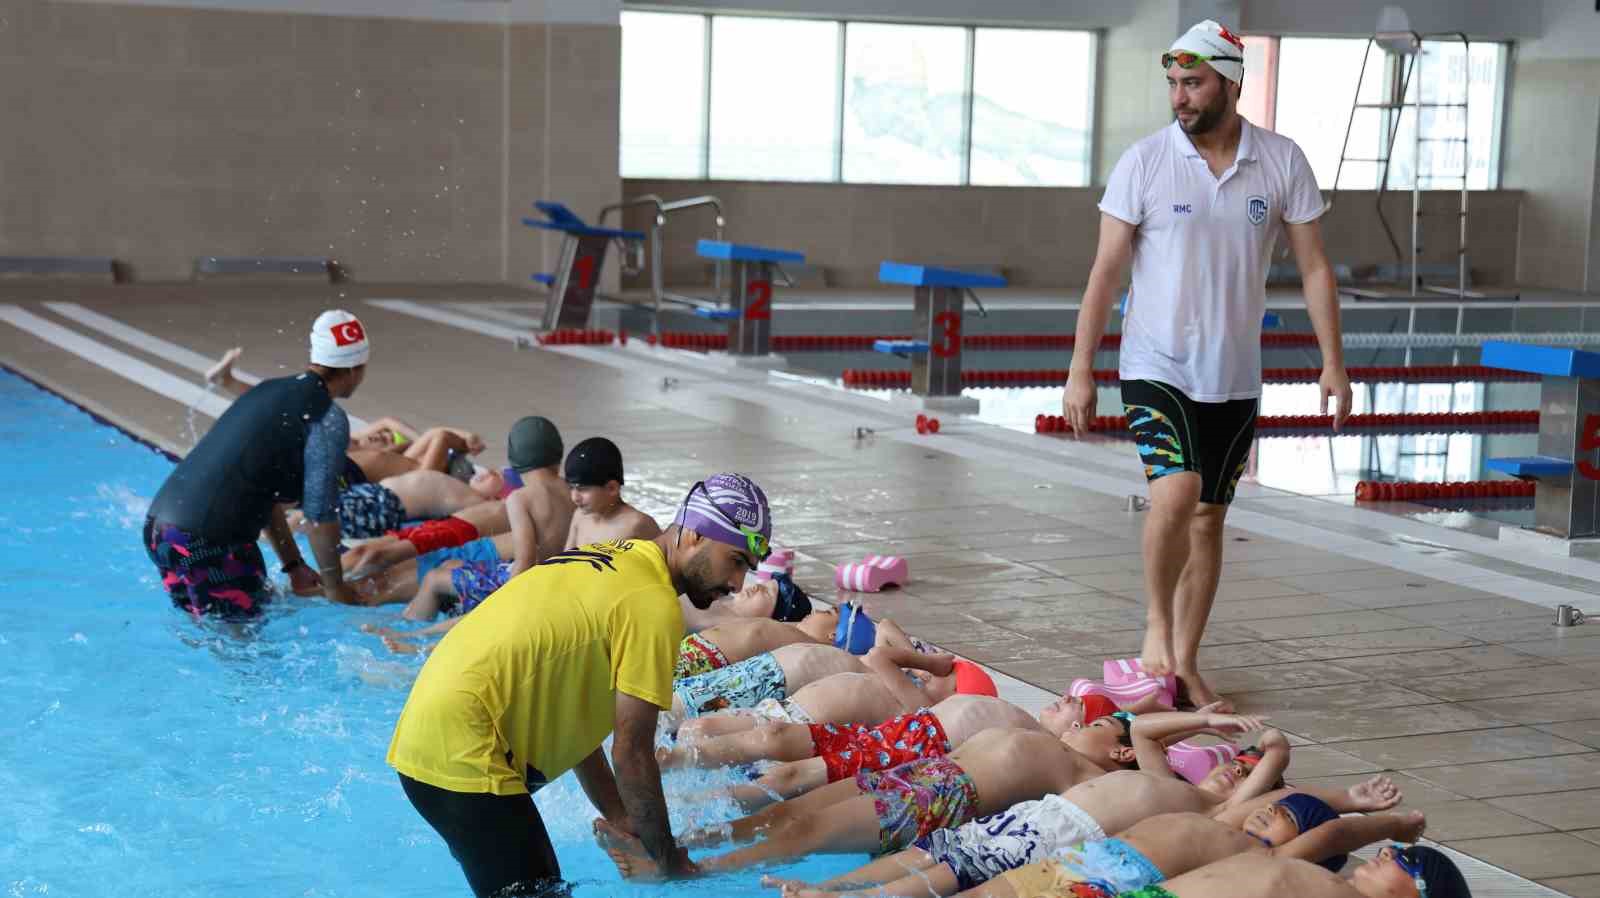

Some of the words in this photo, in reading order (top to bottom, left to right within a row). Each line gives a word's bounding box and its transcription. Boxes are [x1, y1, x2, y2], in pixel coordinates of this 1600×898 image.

[575, 256, 594, 288] 1
[746, 280, 771, 319] 2
[933, 311, 961, 357] 3
